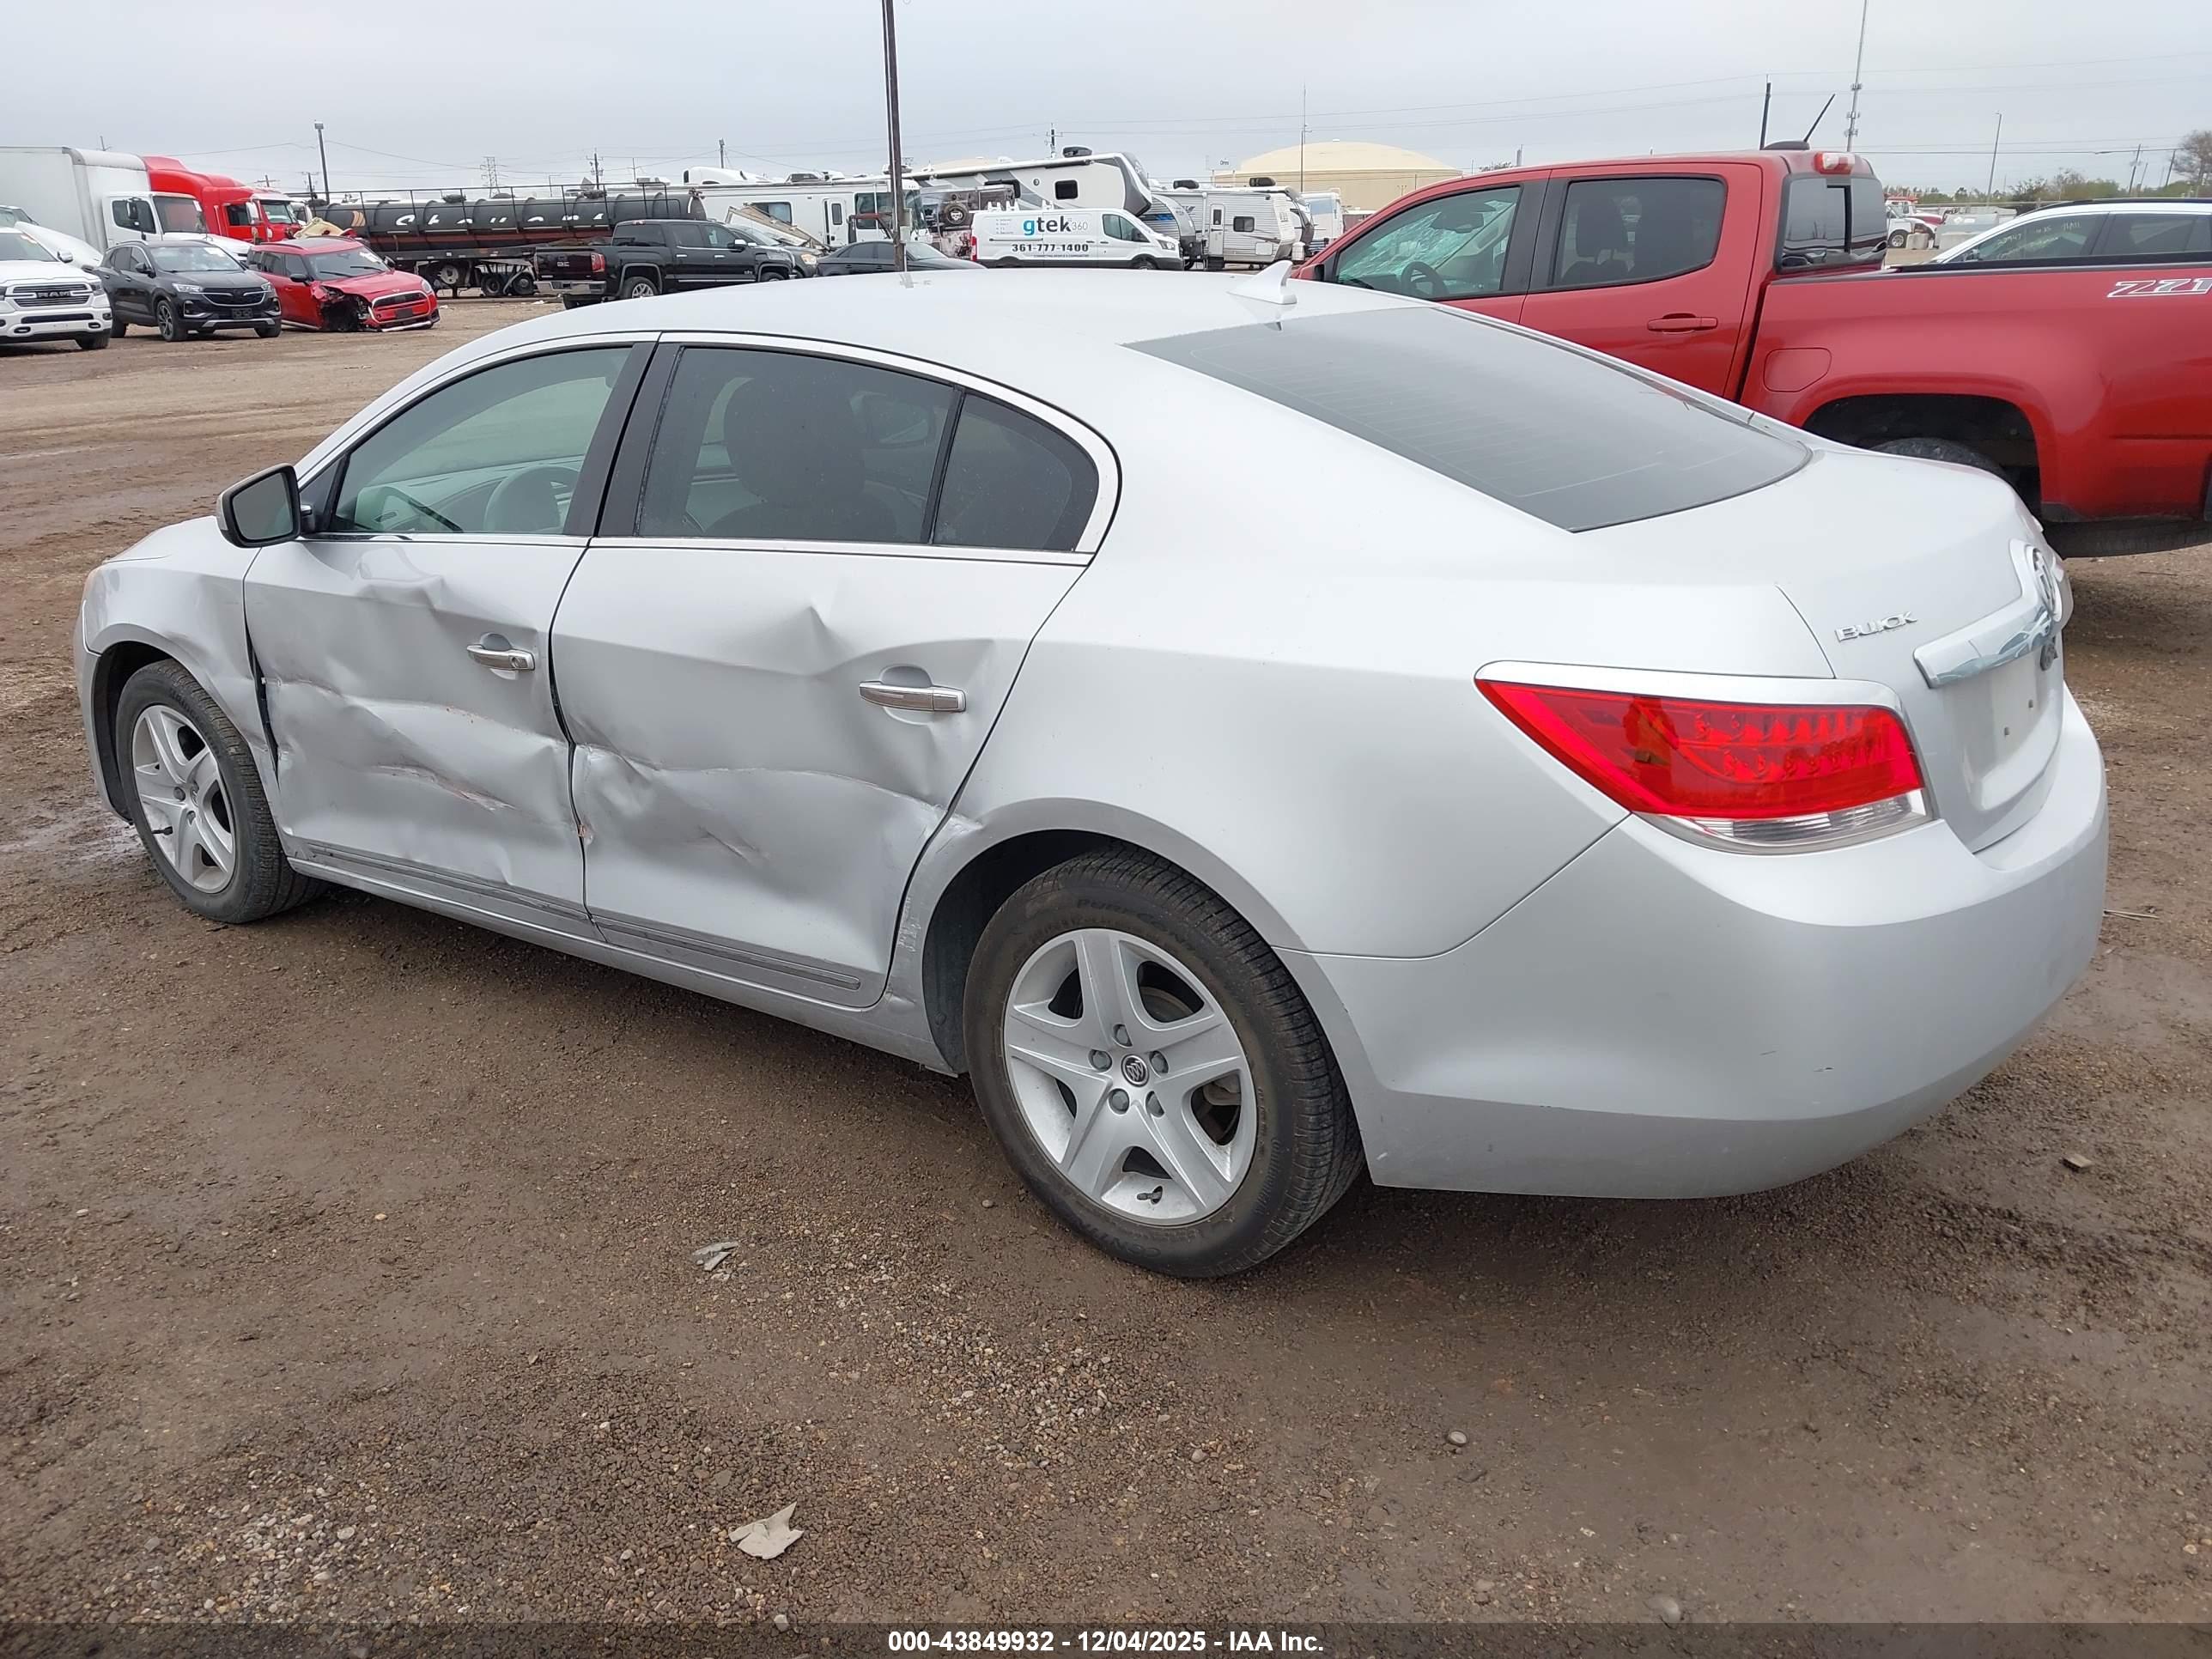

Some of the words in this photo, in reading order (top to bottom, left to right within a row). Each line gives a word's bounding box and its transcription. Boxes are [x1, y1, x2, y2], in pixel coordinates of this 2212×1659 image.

[1023, 215, 1072, 236] gtek
[1072, 222, 1089, 231] 360
[1012, 243, 1089, 252] 361-777-1400
[1834, 611, 1917, 642] BUICK
